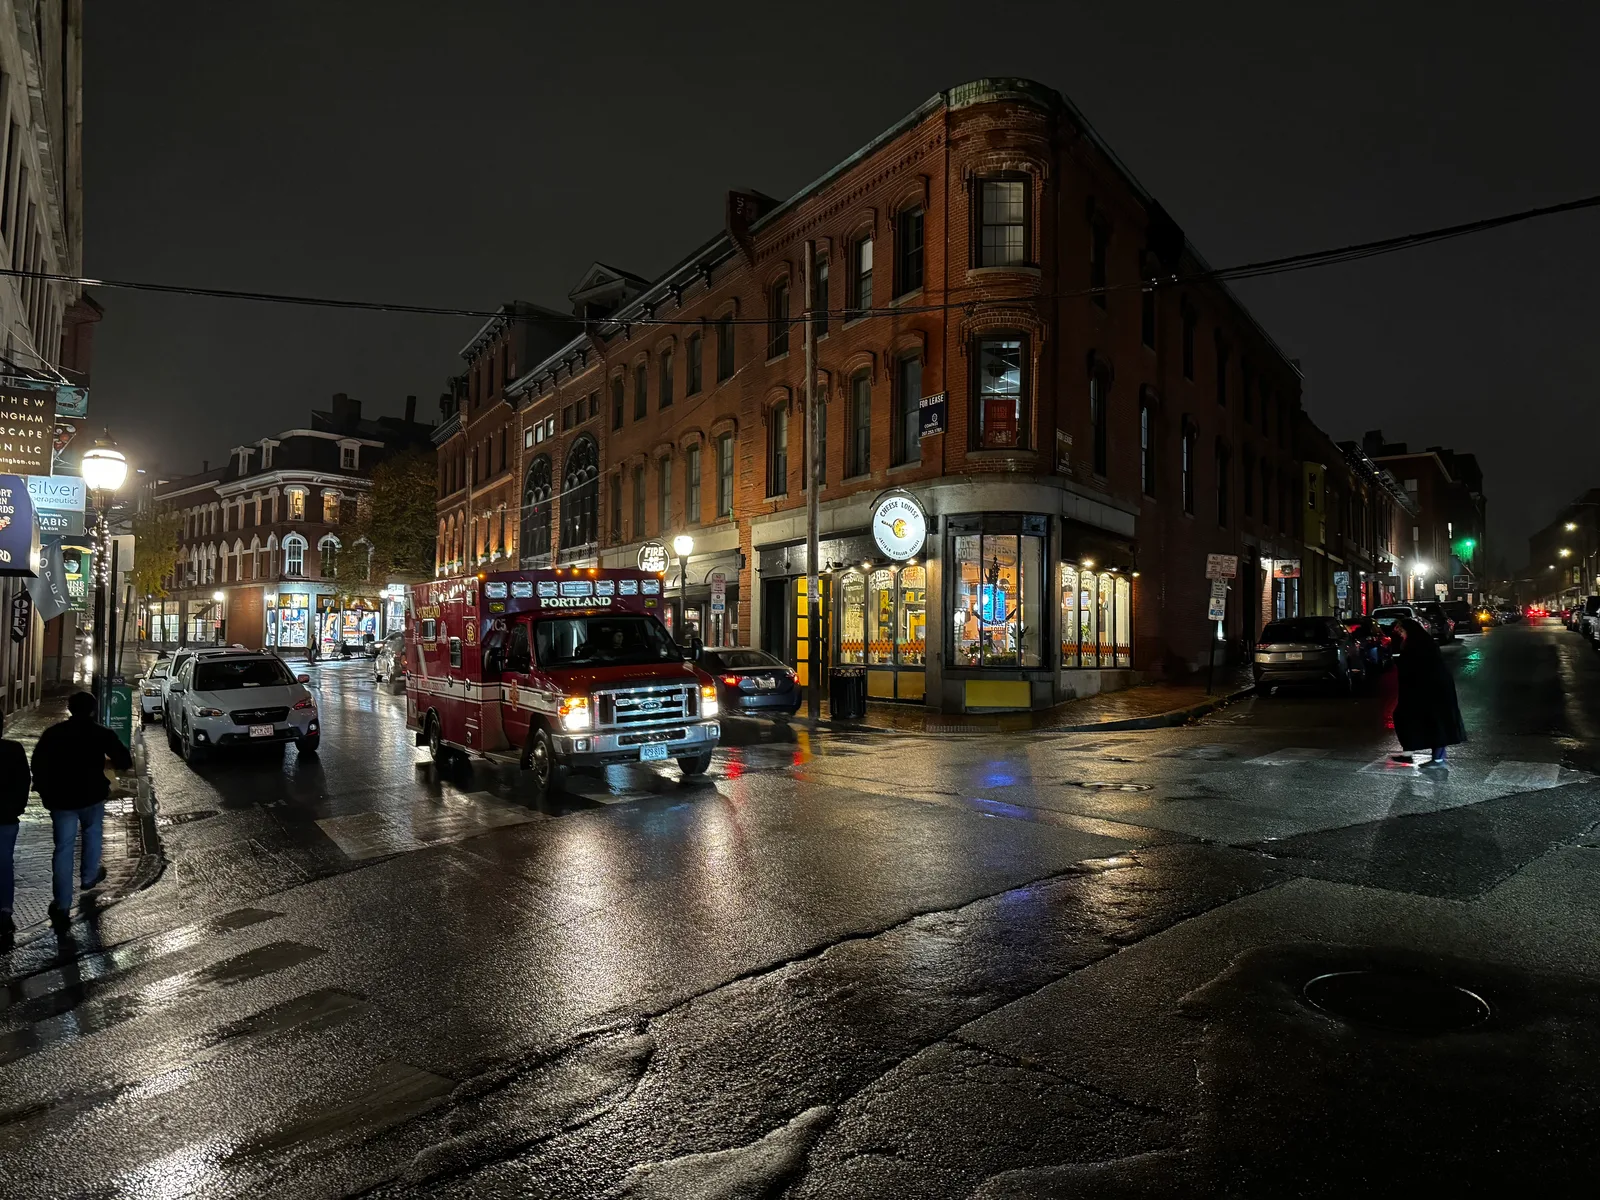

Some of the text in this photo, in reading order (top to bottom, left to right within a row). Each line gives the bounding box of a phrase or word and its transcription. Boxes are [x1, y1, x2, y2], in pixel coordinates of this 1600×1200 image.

[919, 394, 944, 409] FOR LEASE
[20, 444, 42, 454] LLC
[0, 457, 41, 466] ingham.com
[29, 481, 79, 496] silver
[880, 501, 920, 520] CHEESE LOUISE
[645, 546, 664, 558] FIRE
[40, 557, 67, 608] OPEN
[540, 597, 612, 608] PORTLAND
